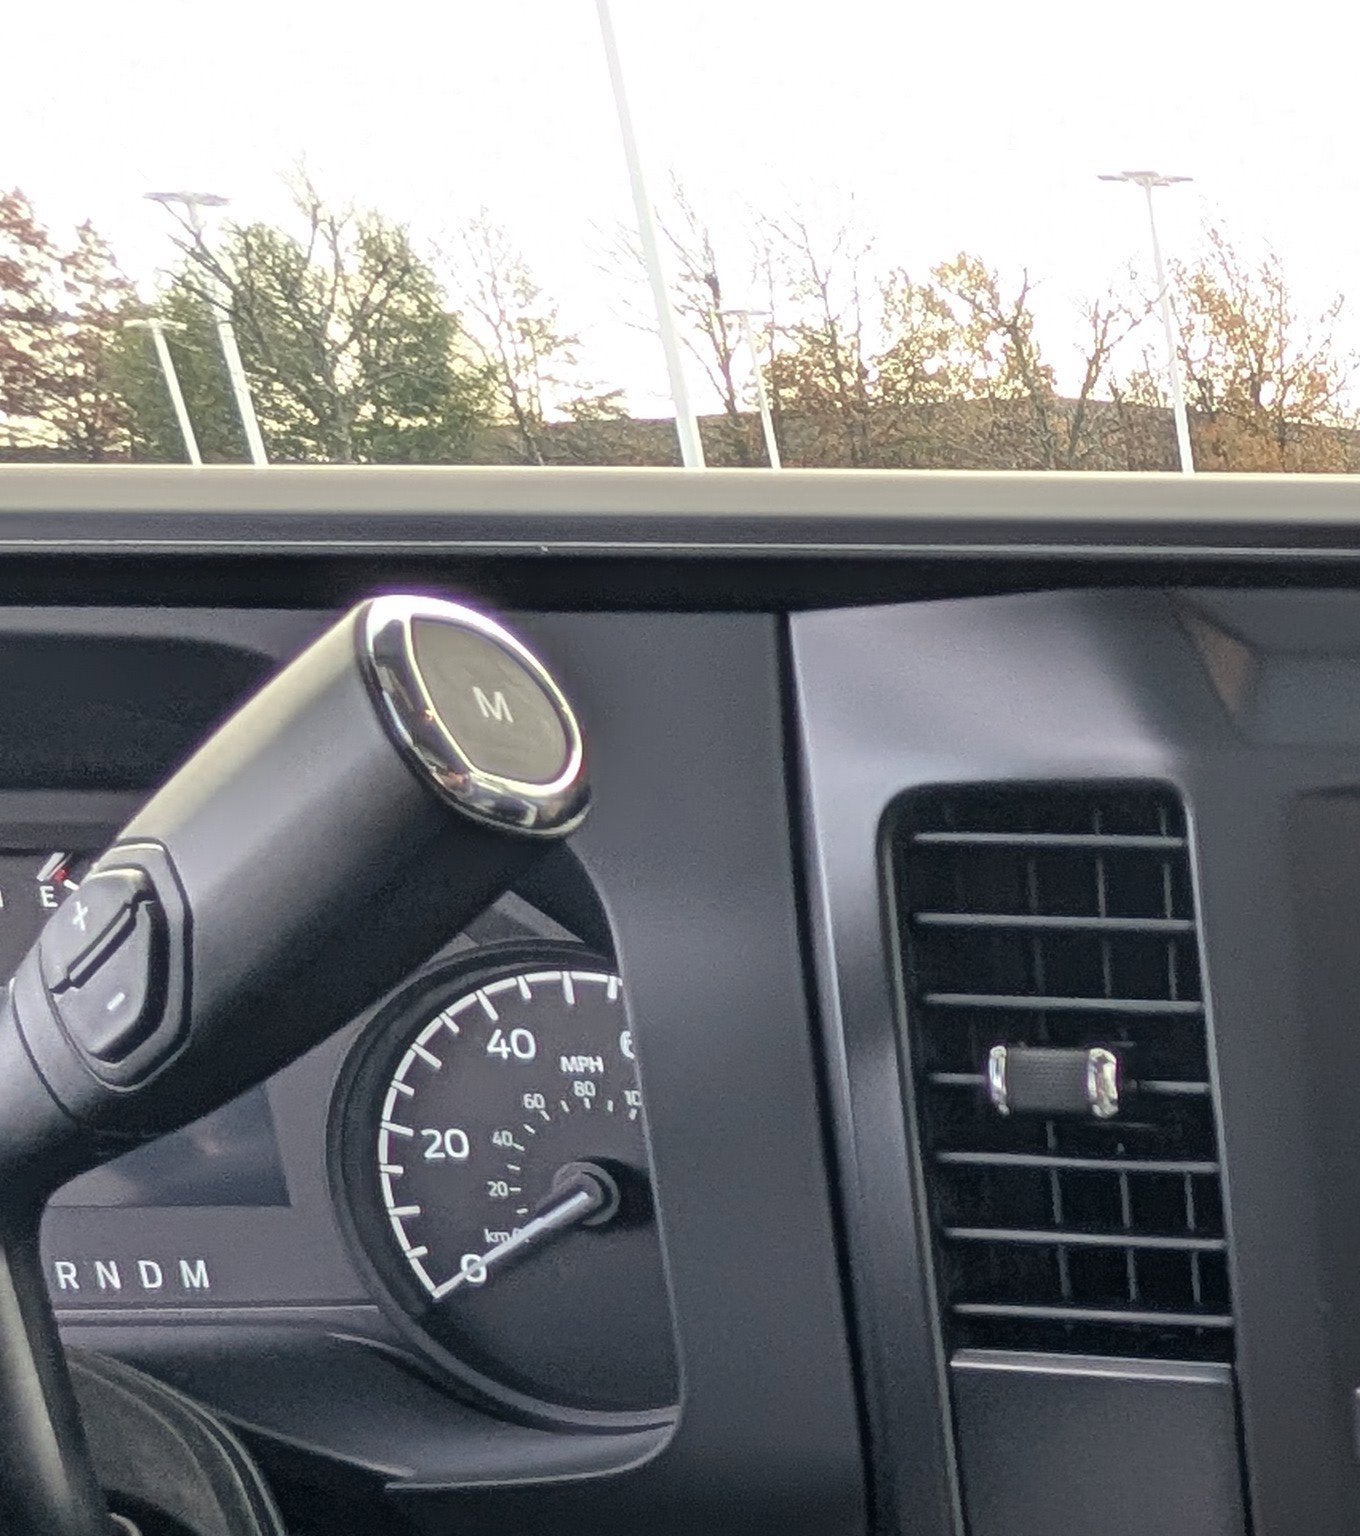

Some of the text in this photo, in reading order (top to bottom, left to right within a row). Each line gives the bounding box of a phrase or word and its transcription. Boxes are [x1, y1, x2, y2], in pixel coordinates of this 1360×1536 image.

[472, 686, 514, 724] M
[40, 885, 58, 908] E
[486, 1028, 537, 1060] 40
[560, 1055, 604, 1073] MPH
[573, 1080, 596, 1098] 80
[523, 1093, 545, 1110] 60
[423, 1128, 470, 1161] 20
[492, 1130, 513, 1147] 40
[487, 1180, 509, 1198] 20
[54, 1259, 210, 1290] R N D M
